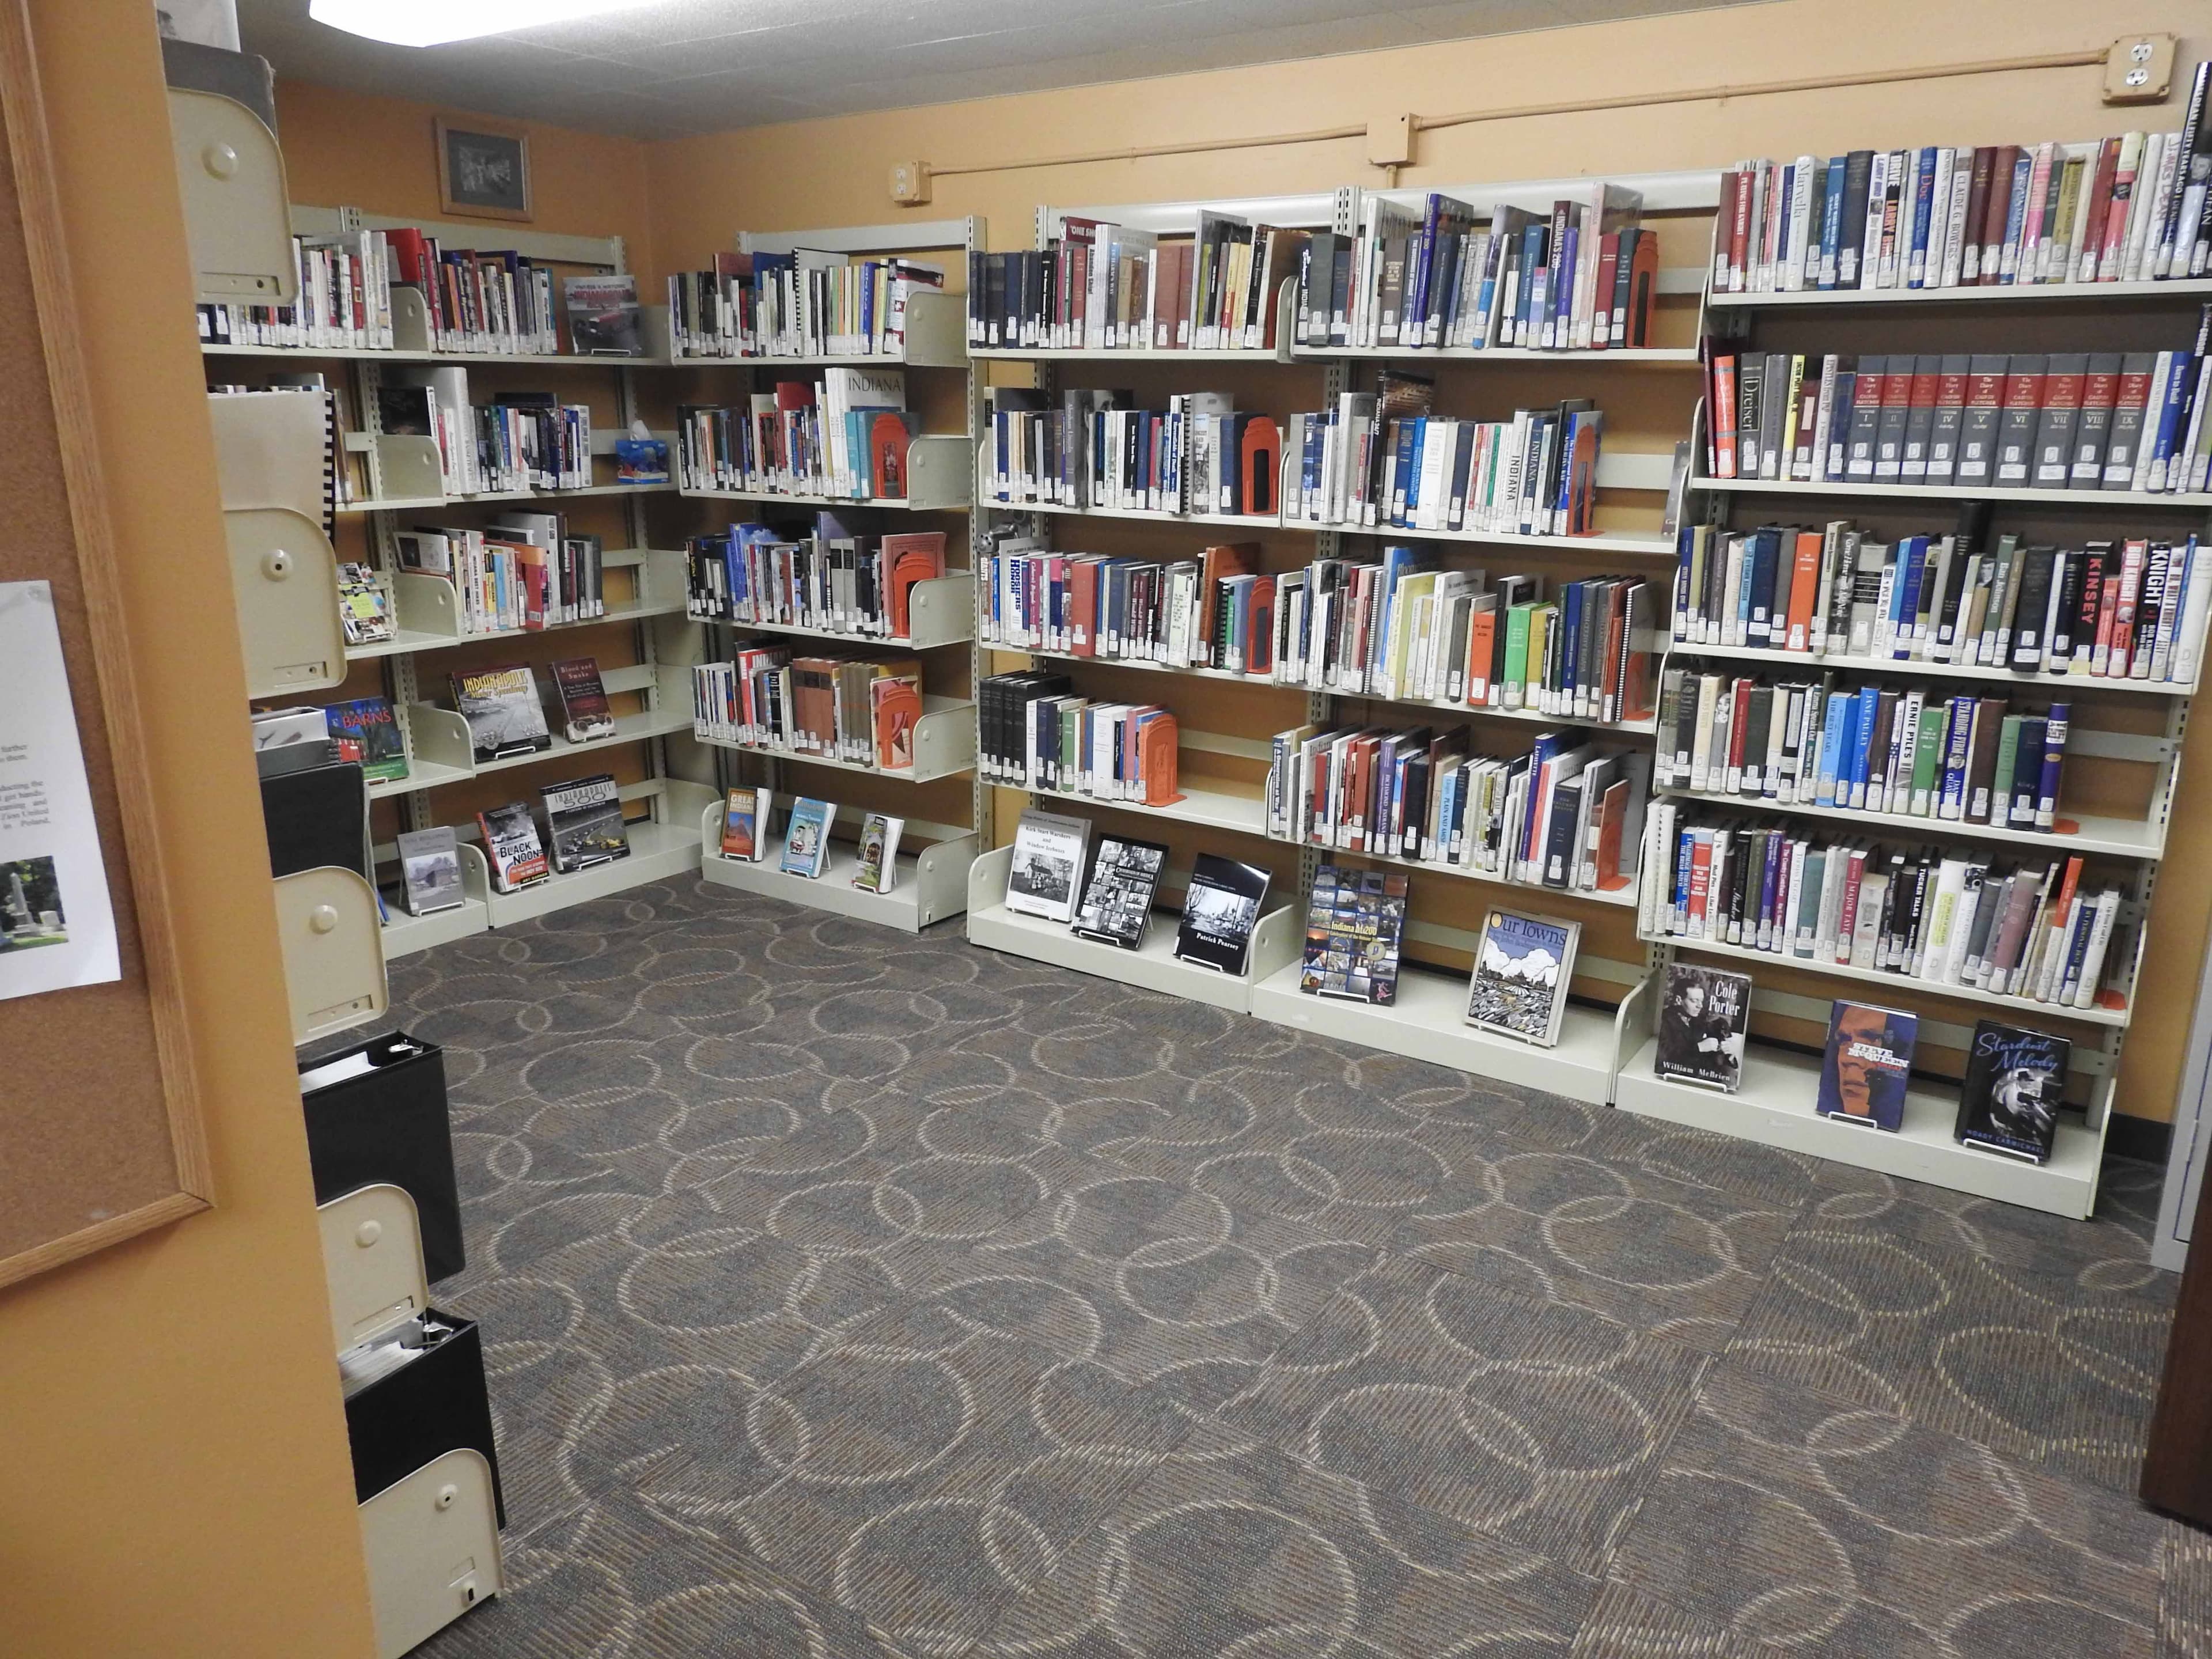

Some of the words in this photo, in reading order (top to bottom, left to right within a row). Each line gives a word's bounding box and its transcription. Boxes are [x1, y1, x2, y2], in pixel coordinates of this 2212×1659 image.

[1876, 158, 1885, 179] LARRY
[1888, 155, 1902, 187] DRIVE
[2179, 149, 2191, 175] YEARS
[1793, 164, 1810, 218] Marvella
[1874, 182, 1884, 197] BIRD
[1953, 175, 1967, 210] CLAUDE
[2175, 176, 2184, 194] AGO
[1884, 199, 1899, 232] LARRY
[2154, 184, 2174, 222] DEAN
[1552, 215, 1566, 252] INDIANA'S
[1947, 224, 1960, 259] BOWERS
[848, 377, 901, 392] INDIANA
[1743, 379, 1760, 429] Dreiser
[1528, 440, 1541, 482] INDIANA
[1506, 456, 1521, 501] INDIANA
[1998, 562, 2009, 578] Ban
[2143, 550, 2169, 607] KNIGHT
[1990, 579, 2005, 613] Johnson
[2081, 558, 2103, 624] KINSEY
[2120, 567, 2139, 602] KNIGHT
[568, 671, 589, 679] Smoke
[1812, 692, 1820, 710] Emma
[1863, 695, 1873, 715] JANE
[1908, 700, 1919, 728] ERNIE
[343, 711, 392, 728] BARNS
[1859, 717, 1871, 746] PAULEY
[1955, 701, 1972, 736] STANDING
[1904, 732, 1915, 759] PYLE'S
[1952, 736, 1968, 754] FIRM
[563, 793, 605, 807] 500
[1382, 774, 1391, 806] RICHMOND
[500, 842, 531, 858] BLACK
[513, 849, 540, 866] NOON
[1915, 868, 1926, 895] TUCKER
[1845, 885, 1856, 911] MAJOR
[1912, 897, 1921, 916] TALKS
[1196, 932, 1217, 944] Patrick
[1332, 921, 1355, 933] Indiana
[1365, 925, 1377, 936] 200
[1715, 980, 1737, 999] Cole
[1709, 995, 1740, 1016] Porter
[1976, 1032, 2051, 1056] Stardust
[1663, 1061, 1694, 1074] William
[1699, 1068, 1730, 1081] McBrien
[1990, 1051, 2058, 1073] Melody
